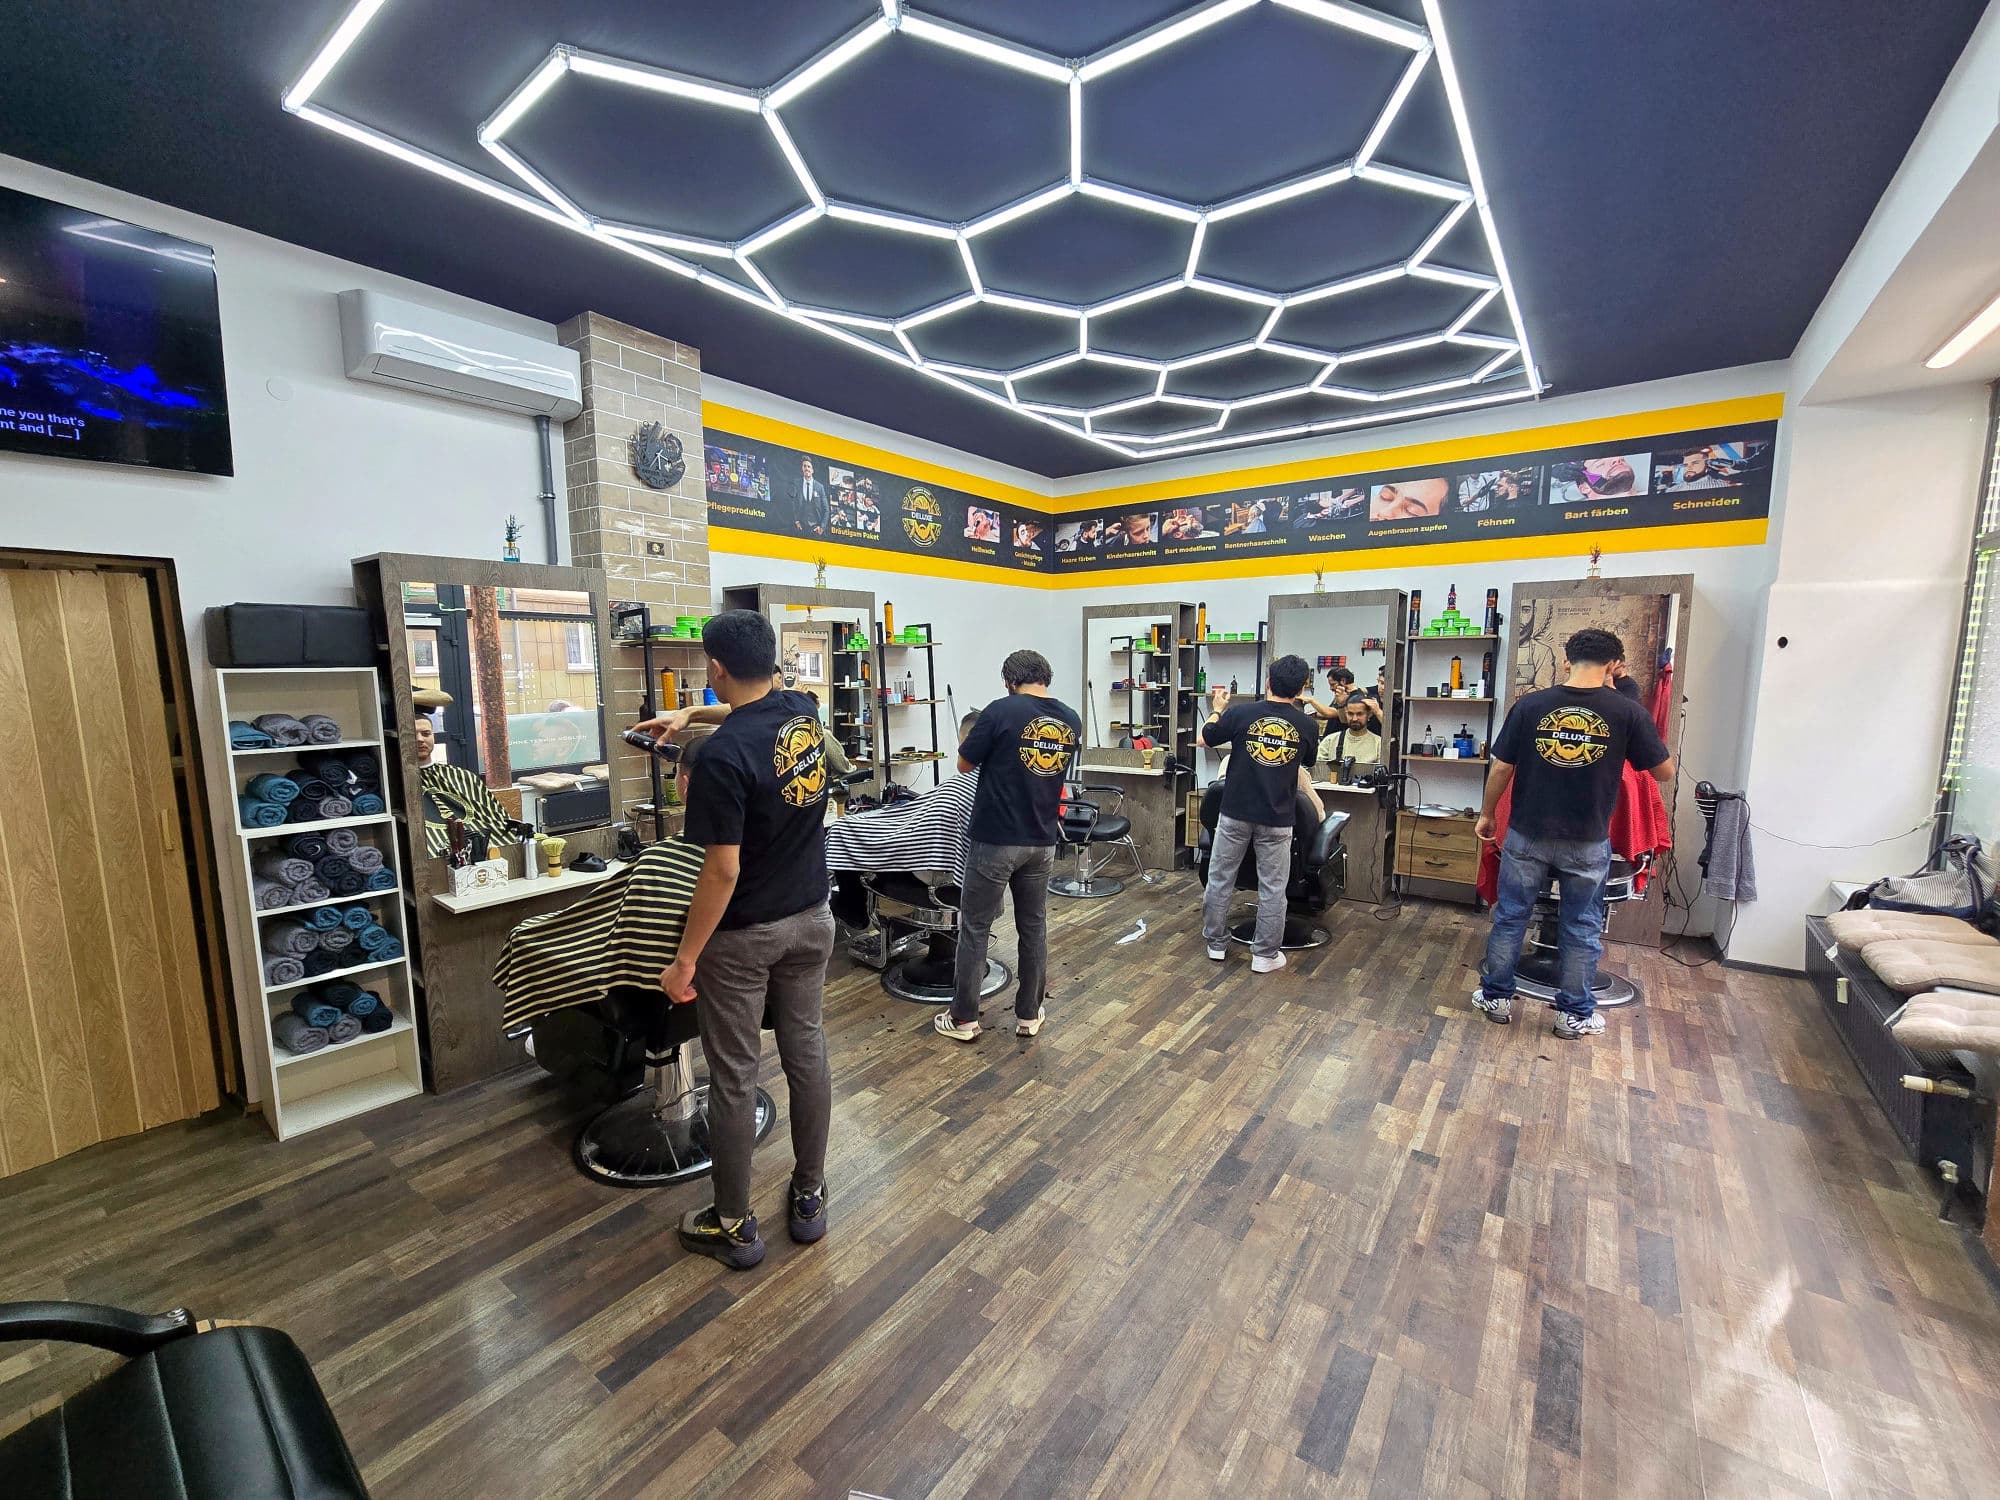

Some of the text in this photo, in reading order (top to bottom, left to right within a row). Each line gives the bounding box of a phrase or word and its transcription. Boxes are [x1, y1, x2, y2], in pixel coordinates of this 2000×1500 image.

[18, 410, 45, 421] you
[47, 413, 86, 428] that's
[18, 423, 45, 434] and
[1672, 497, 1741, 511] Schneiden
[911, 511, 934, 522] DELUXE
[1564, 506, 1629, 520] Bart färben
[1477, 517, 1516, 528] Föhnen
[1367, 523, 1448, 538] Augenbrauen zupfen
[863, 532, 880, 541] Paket
[1308, 532, 1346, 542] Waschen
[1179, 544, 1217, 554] modellieren
[1106, 550, 1157, 560] Kinderhaarschnitt
[1257, 736, 1288, 747] DELUXE
[1552, 731, 1592, 743] DELUXE
[1033, 740, 1064, 752] DELUXE
